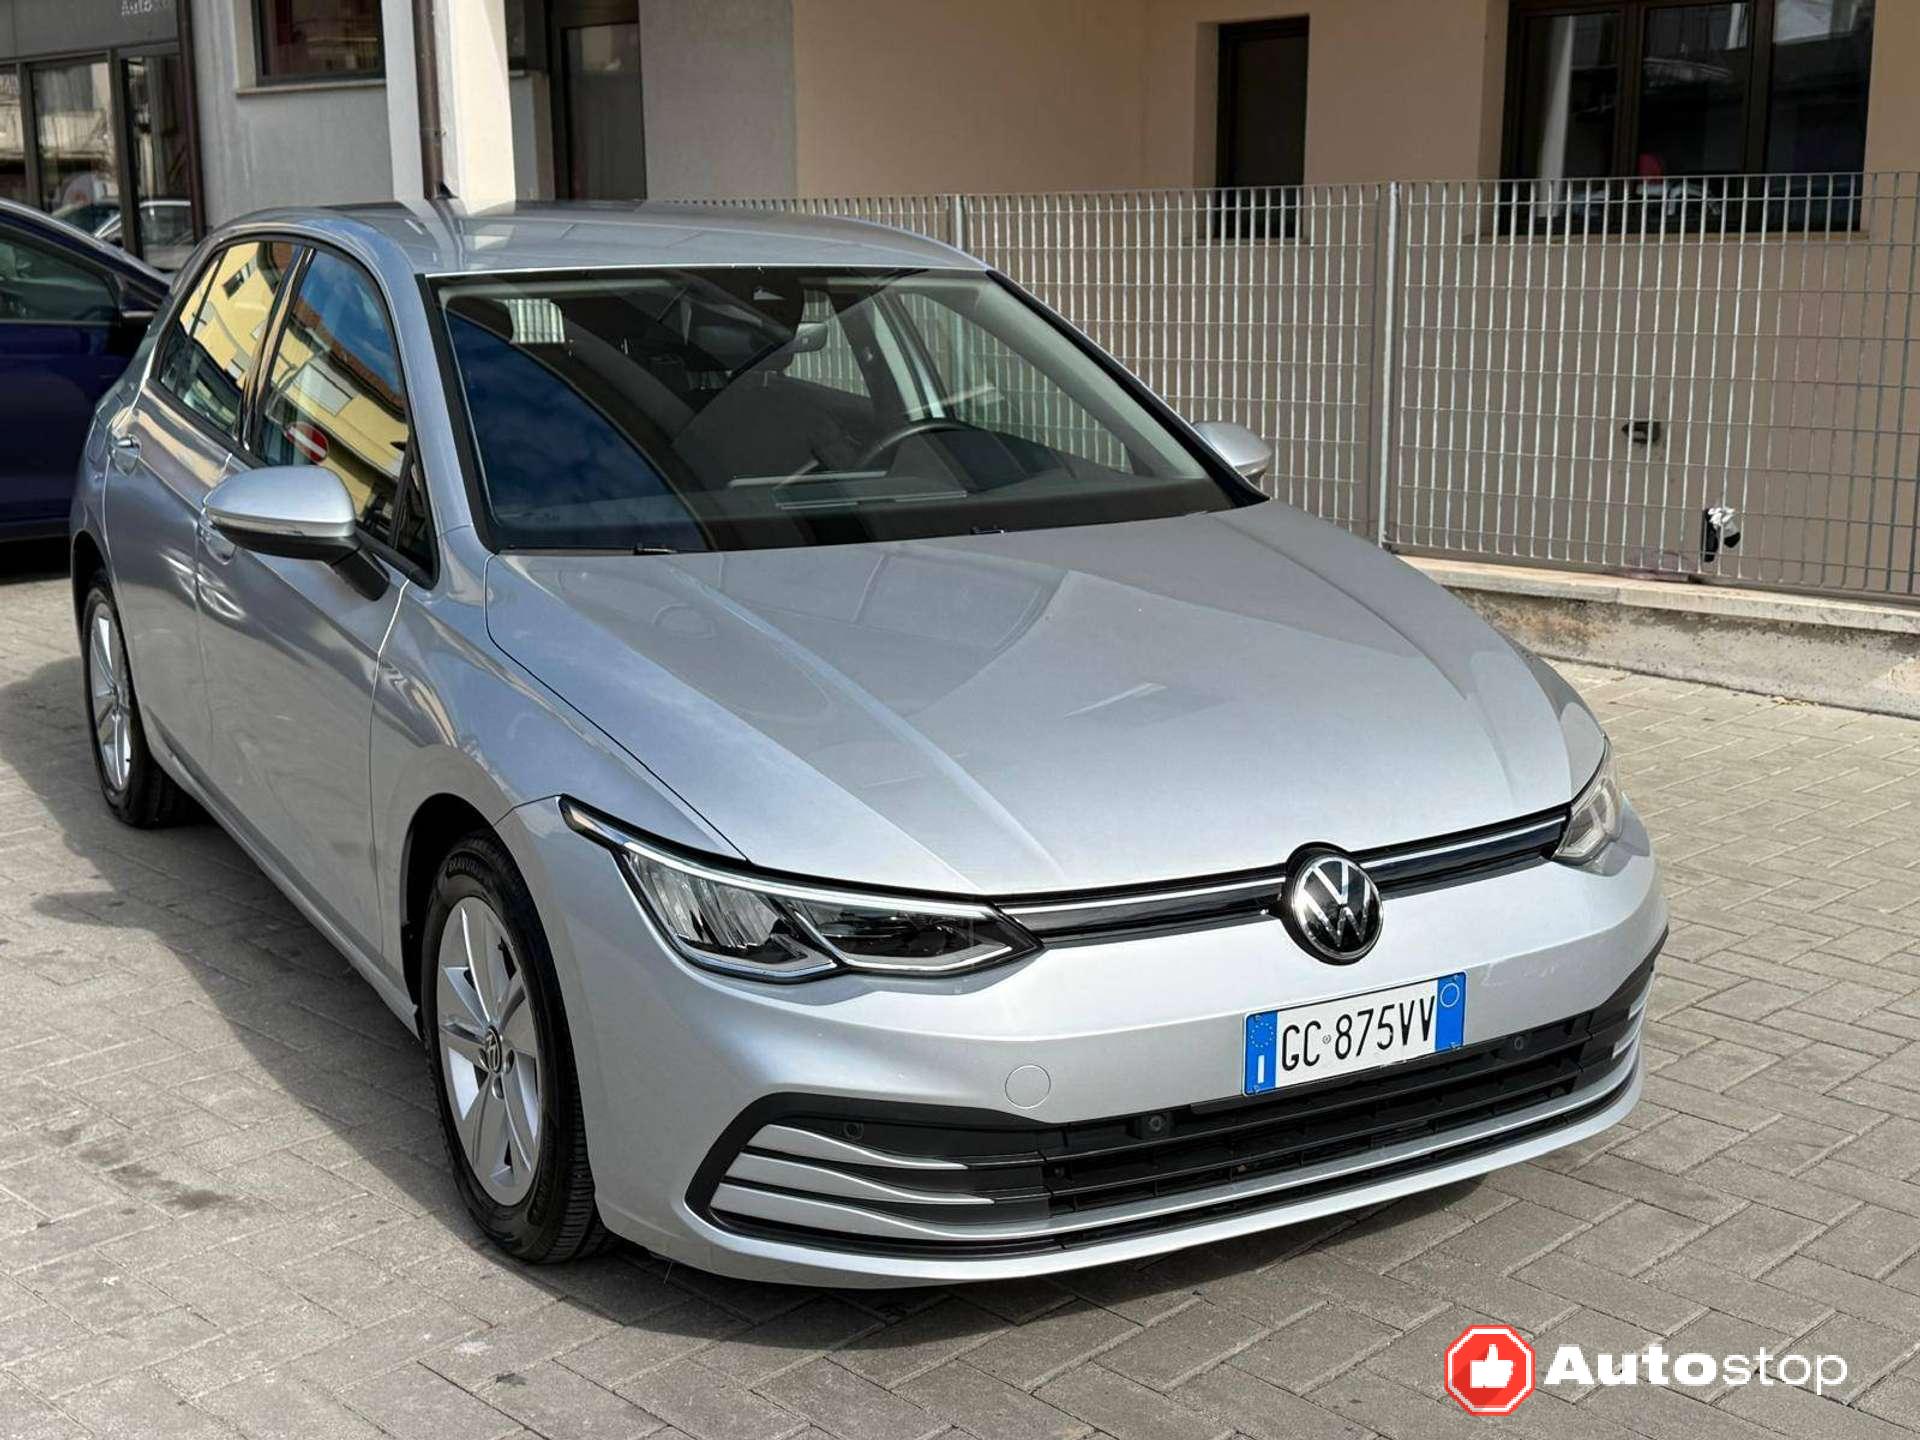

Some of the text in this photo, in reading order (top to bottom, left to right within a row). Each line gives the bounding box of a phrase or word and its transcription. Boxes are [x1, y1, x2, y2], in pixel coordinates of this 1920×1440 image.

[1293, 857, 1384, 959] VW
[1256, 1054, 1266, 1083] I
[1281, 995, 1436, 1071] GC 875VV
